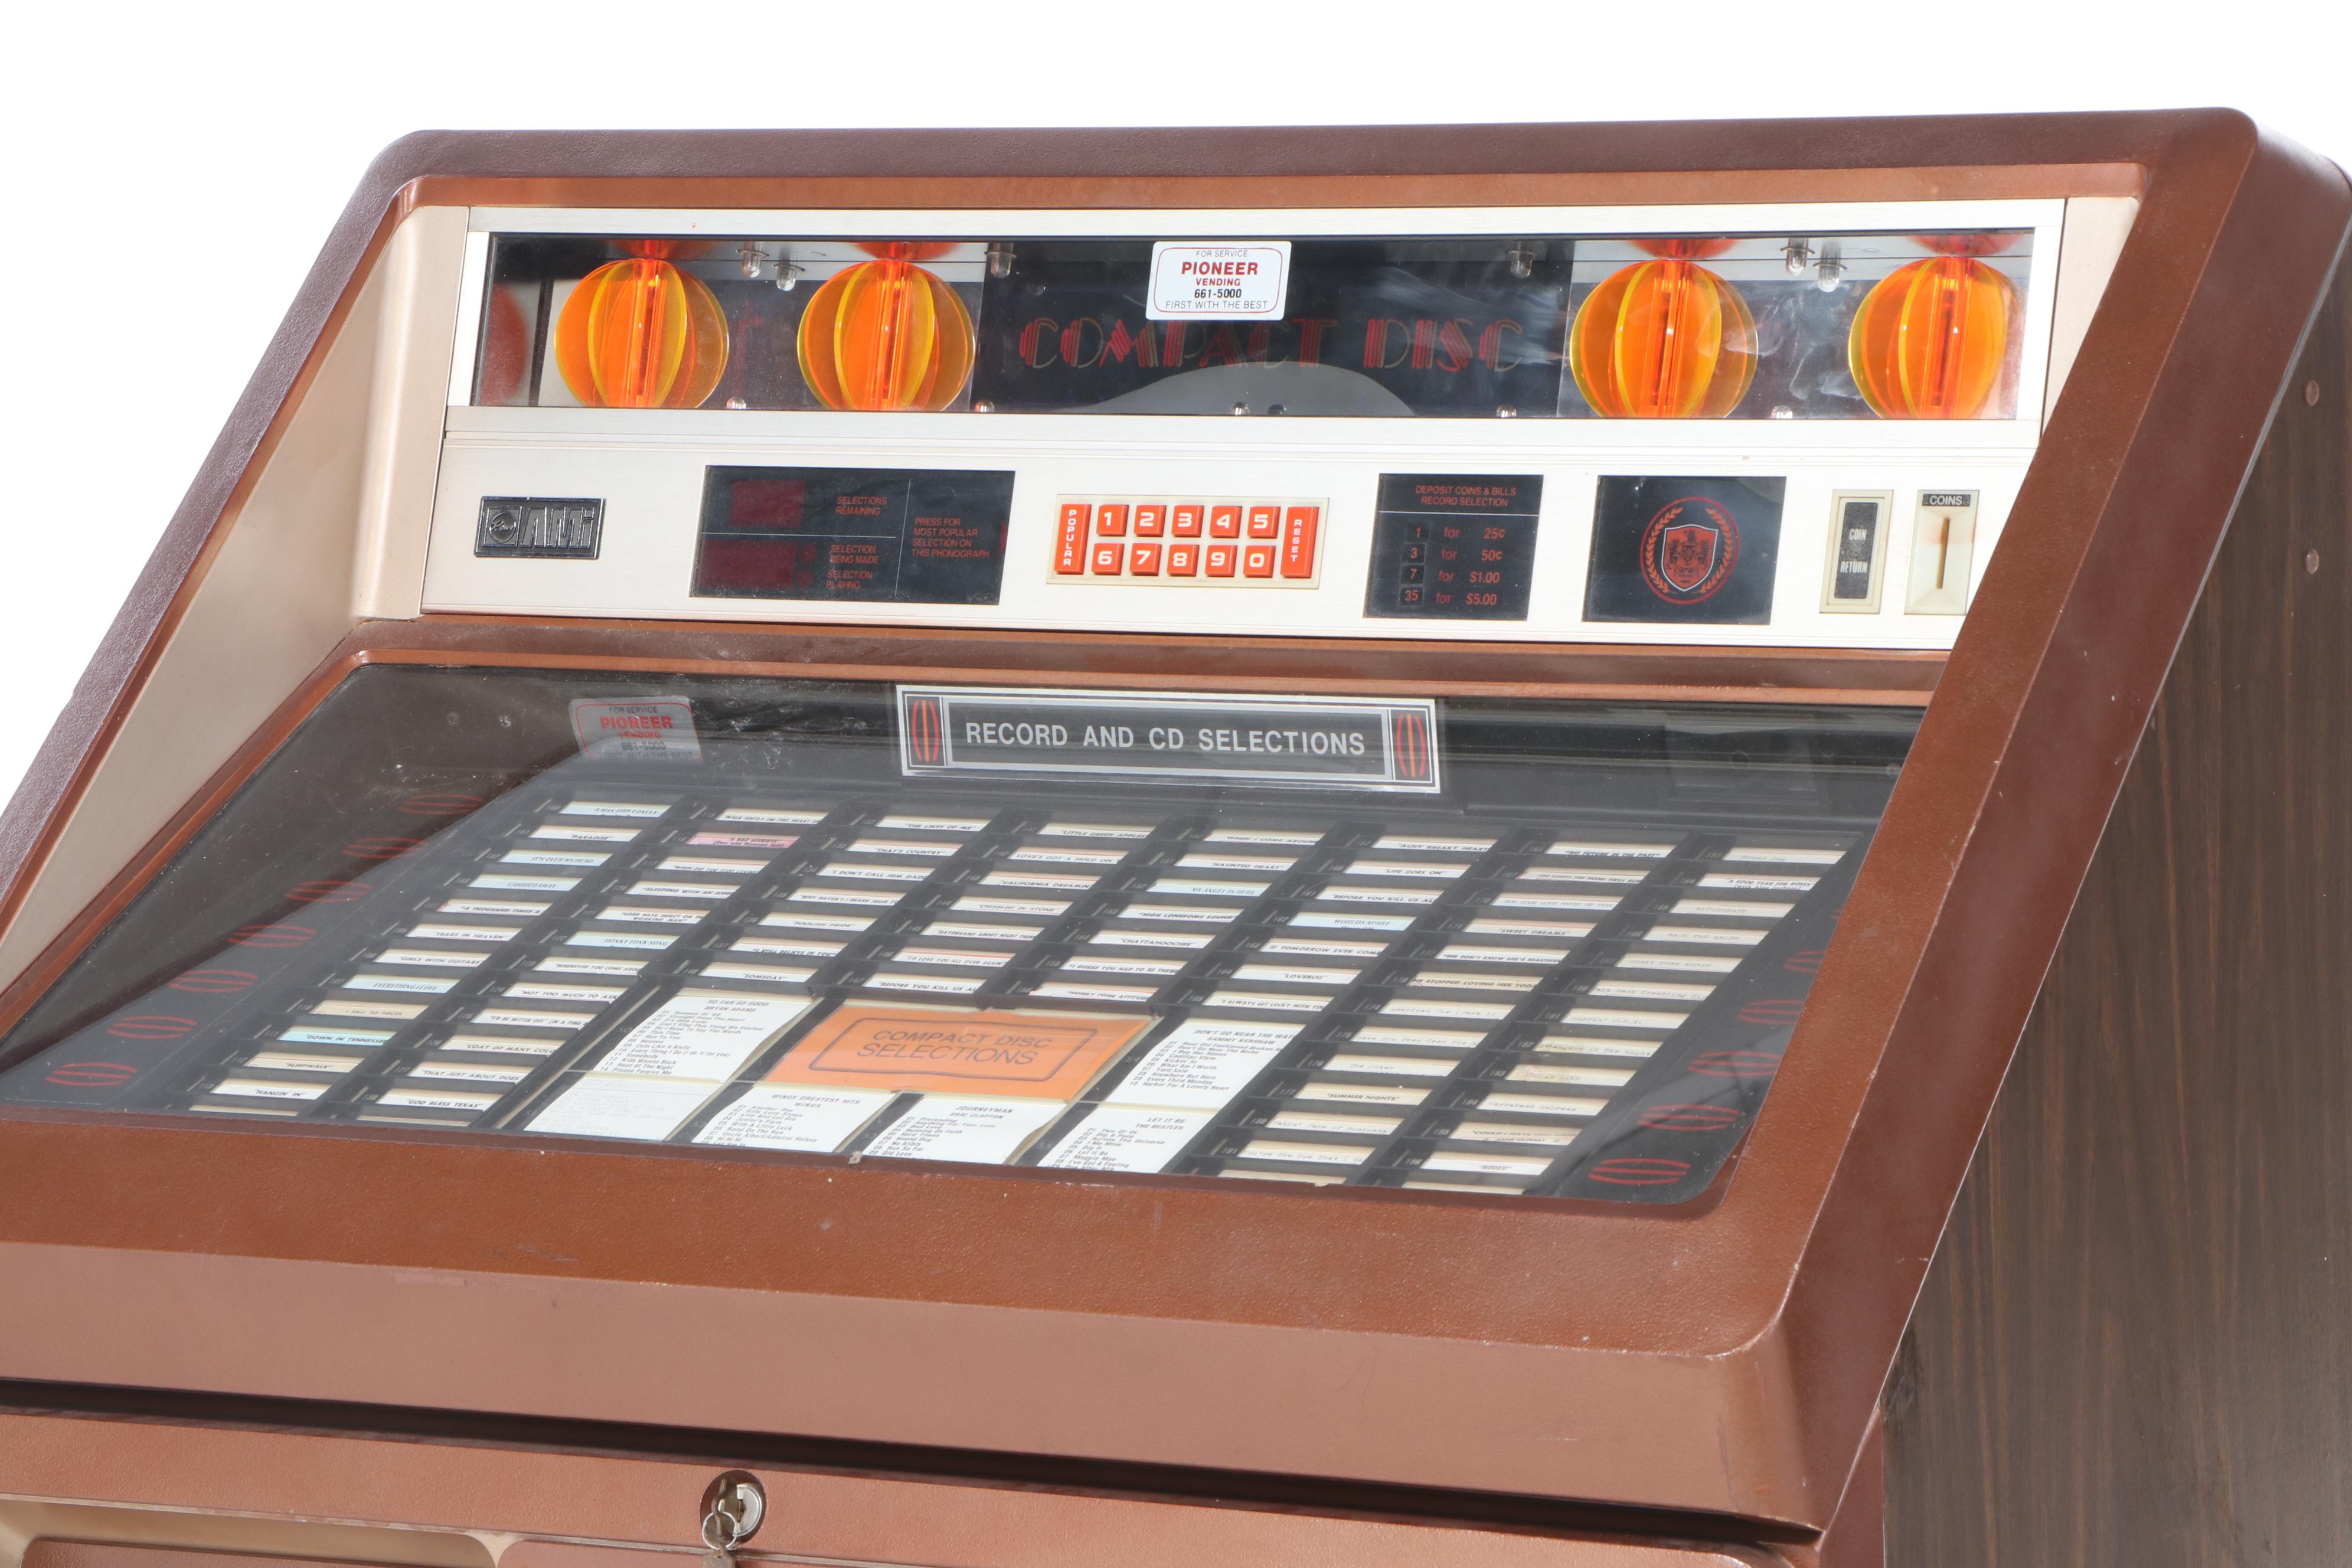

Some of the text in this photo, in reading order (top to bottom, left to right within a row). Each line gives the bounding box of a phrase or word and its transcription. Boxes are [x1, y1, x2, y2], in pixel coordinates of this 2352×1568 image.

[1181, 262, 1259, 275] PIONEER
[1194, 289, 1242, 298] 661-5000
[1165, 300, 1192, 309] FIRST
[1243, 301, 1268, 309] BEST
[1019, 317, 1523, 373] COMPACT DISC
[1416, 485, 1516, 496] DEPOSIT COINS & BILLS
[837, 496, 887, 505] SELECTIONS
[1421, 496, 1508, 507] RECORD SELECTION
[1929, 495, 1963, 505] COINS
[835, 507, 881, 515] REMAINING
[1103, 512, 1268, 528] 1 2 3 4 5
[914, 528, 937, 536] MOST
[1063, 509, 1077, 566] POPULAR
[1416, 527, 1422, 538] 1
[1444, 527, 1461, 538] for
[1849, 528, 1867, 540] COIN
[912, 538, 957, 547] SELECTION
[1291, 519, 1302, 562] RESET
[831, 545, 876, 553] SELECTION
[932, 549, 989, 558] PHONOGRAPH
[1410, 548, 1418, 558] 3
[1442, 548, 1458, 560] for
[1097, 551, 1265, 567] 6 7 8 9 0
[1840, 561, 1868, 573] RETURN
[828, 570, 873, 579] SELECTION
[1410, 569, 1500, 583] 7 for $1.00
[827, 581, 860, 589] PLAYING
[1404, 590, 1497, 605] 35 for $5.00
[600, 715, 674, 729] PIONEER
[966, 722, 1366, 756] RECORD AND CD SELECTIONS
[873, 1030, 1052, 1049] COMPACT DISC
[857, 1043, 1038, 1064] SELECTIONS
